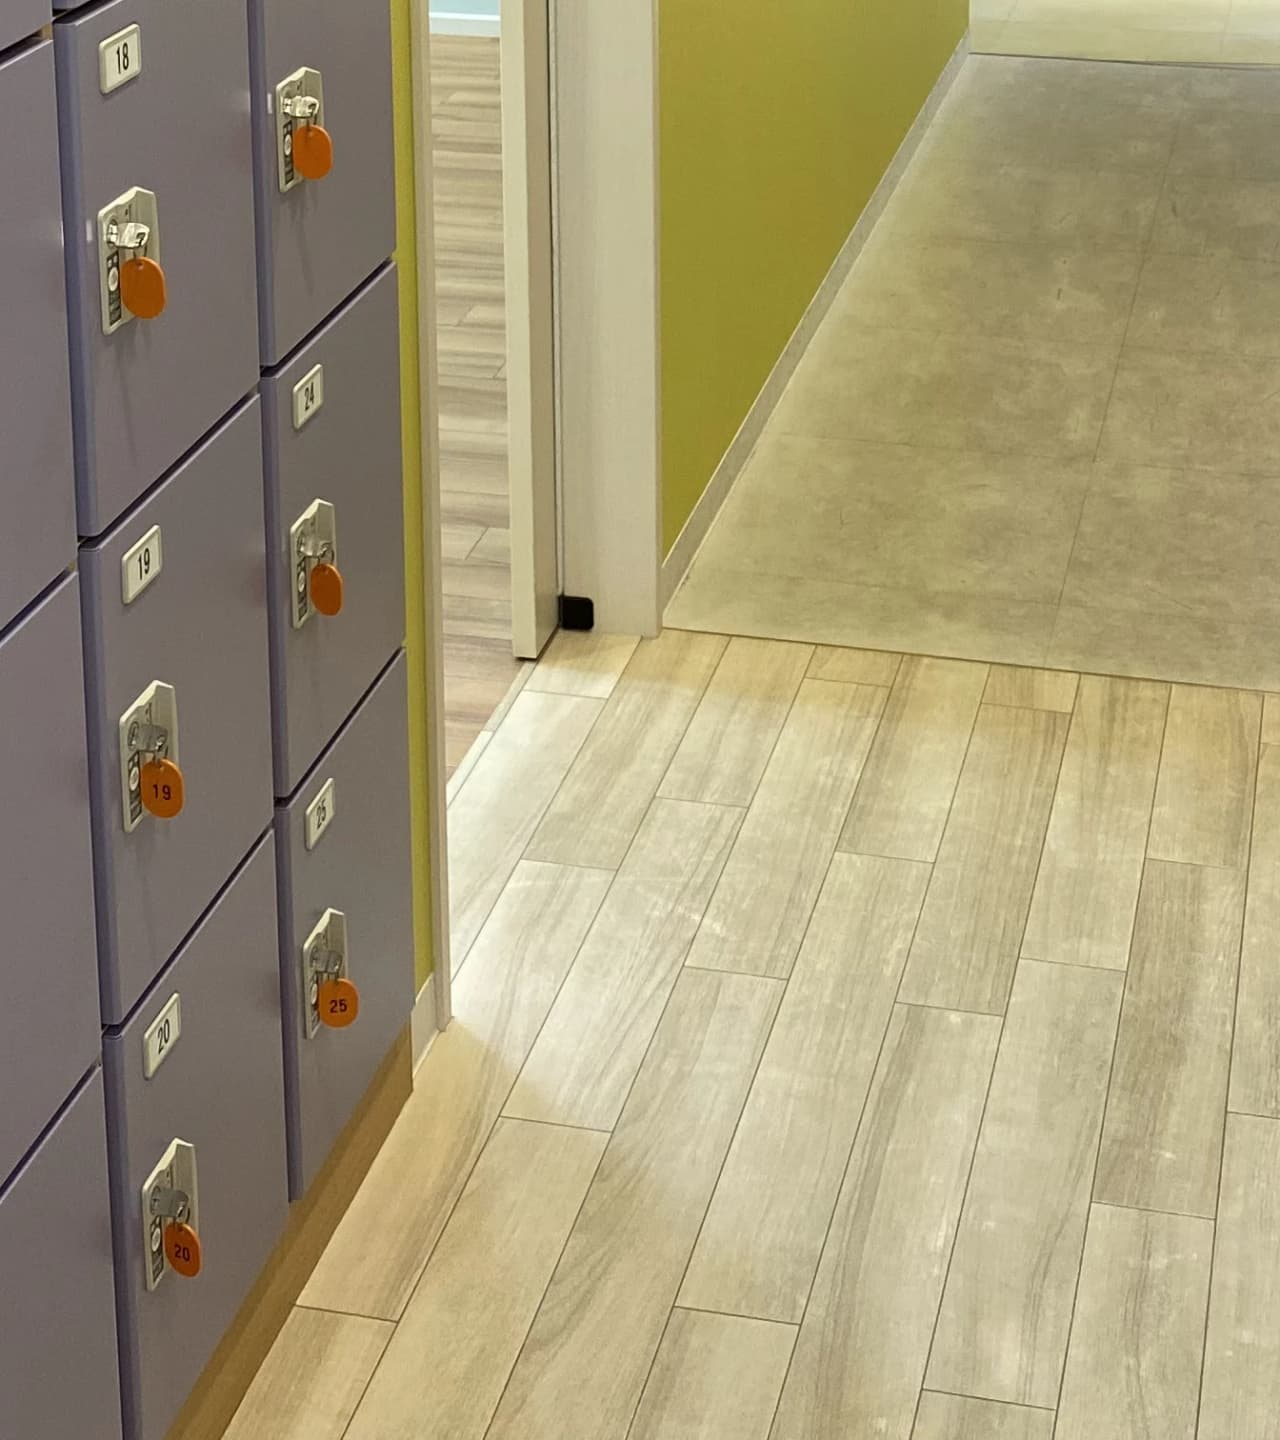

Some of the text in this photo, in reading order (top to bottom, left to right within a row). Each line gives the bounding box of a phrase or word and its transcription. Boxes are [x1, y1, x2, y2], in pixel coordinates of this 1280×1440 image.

[116, 42, 130, 74] 18
[304, 382, 315, 411] 24
[138, 547, 151, 580] 19
[152, 783, 172, 801] 19
[316, 798, 327, 830] 25
[329, 998, 348, 1014] 25
[157, 1018, 170, 1055] 20
[174, 1243, 191, 1262] 20
